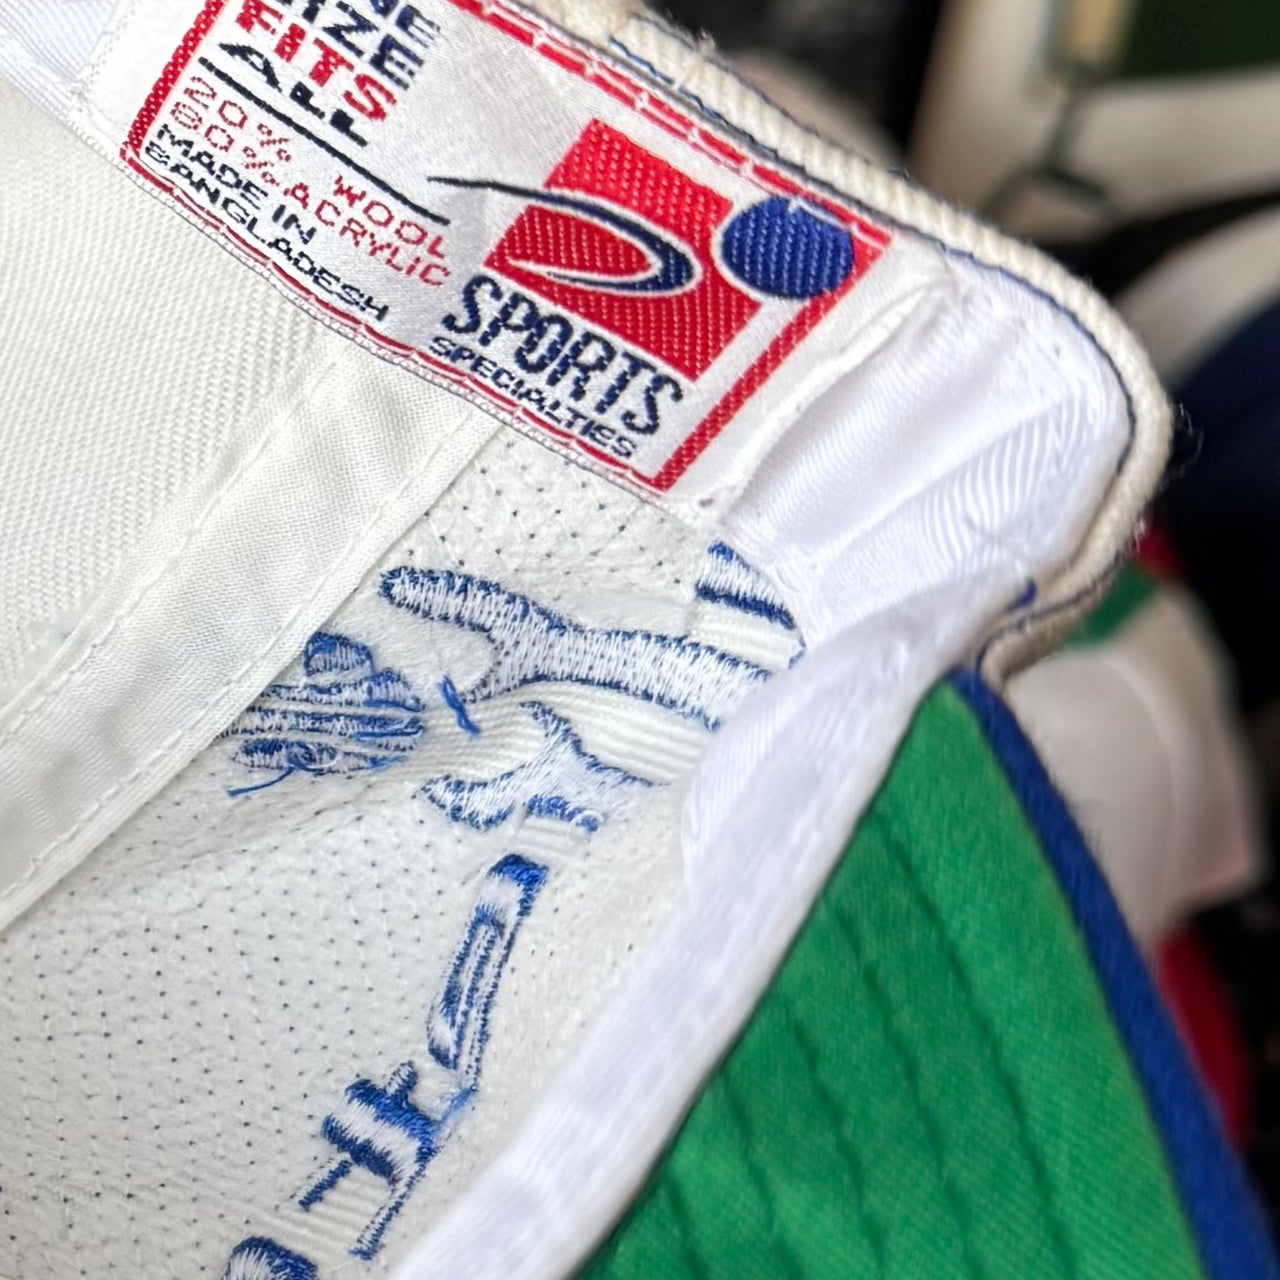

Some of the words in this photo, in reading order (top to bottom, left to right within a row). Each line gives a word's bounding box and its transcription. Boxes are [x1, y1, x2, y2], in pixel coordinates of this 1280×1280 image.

[218, 41, 368, 148] ALL
[155, 122, 269, 211] MADE
[271, 203, 317, 246] IN
[183, 75, 292, 162] 20%
[333, 174, 446, 260] WOOL
[144, 140, 390, 323] BANGLADESH
[283, 181, 452, 287] ACRYLIC
[428, 335, 637, 459] SPECIALTIES
[441, 274, 684, 436] SPORTS
